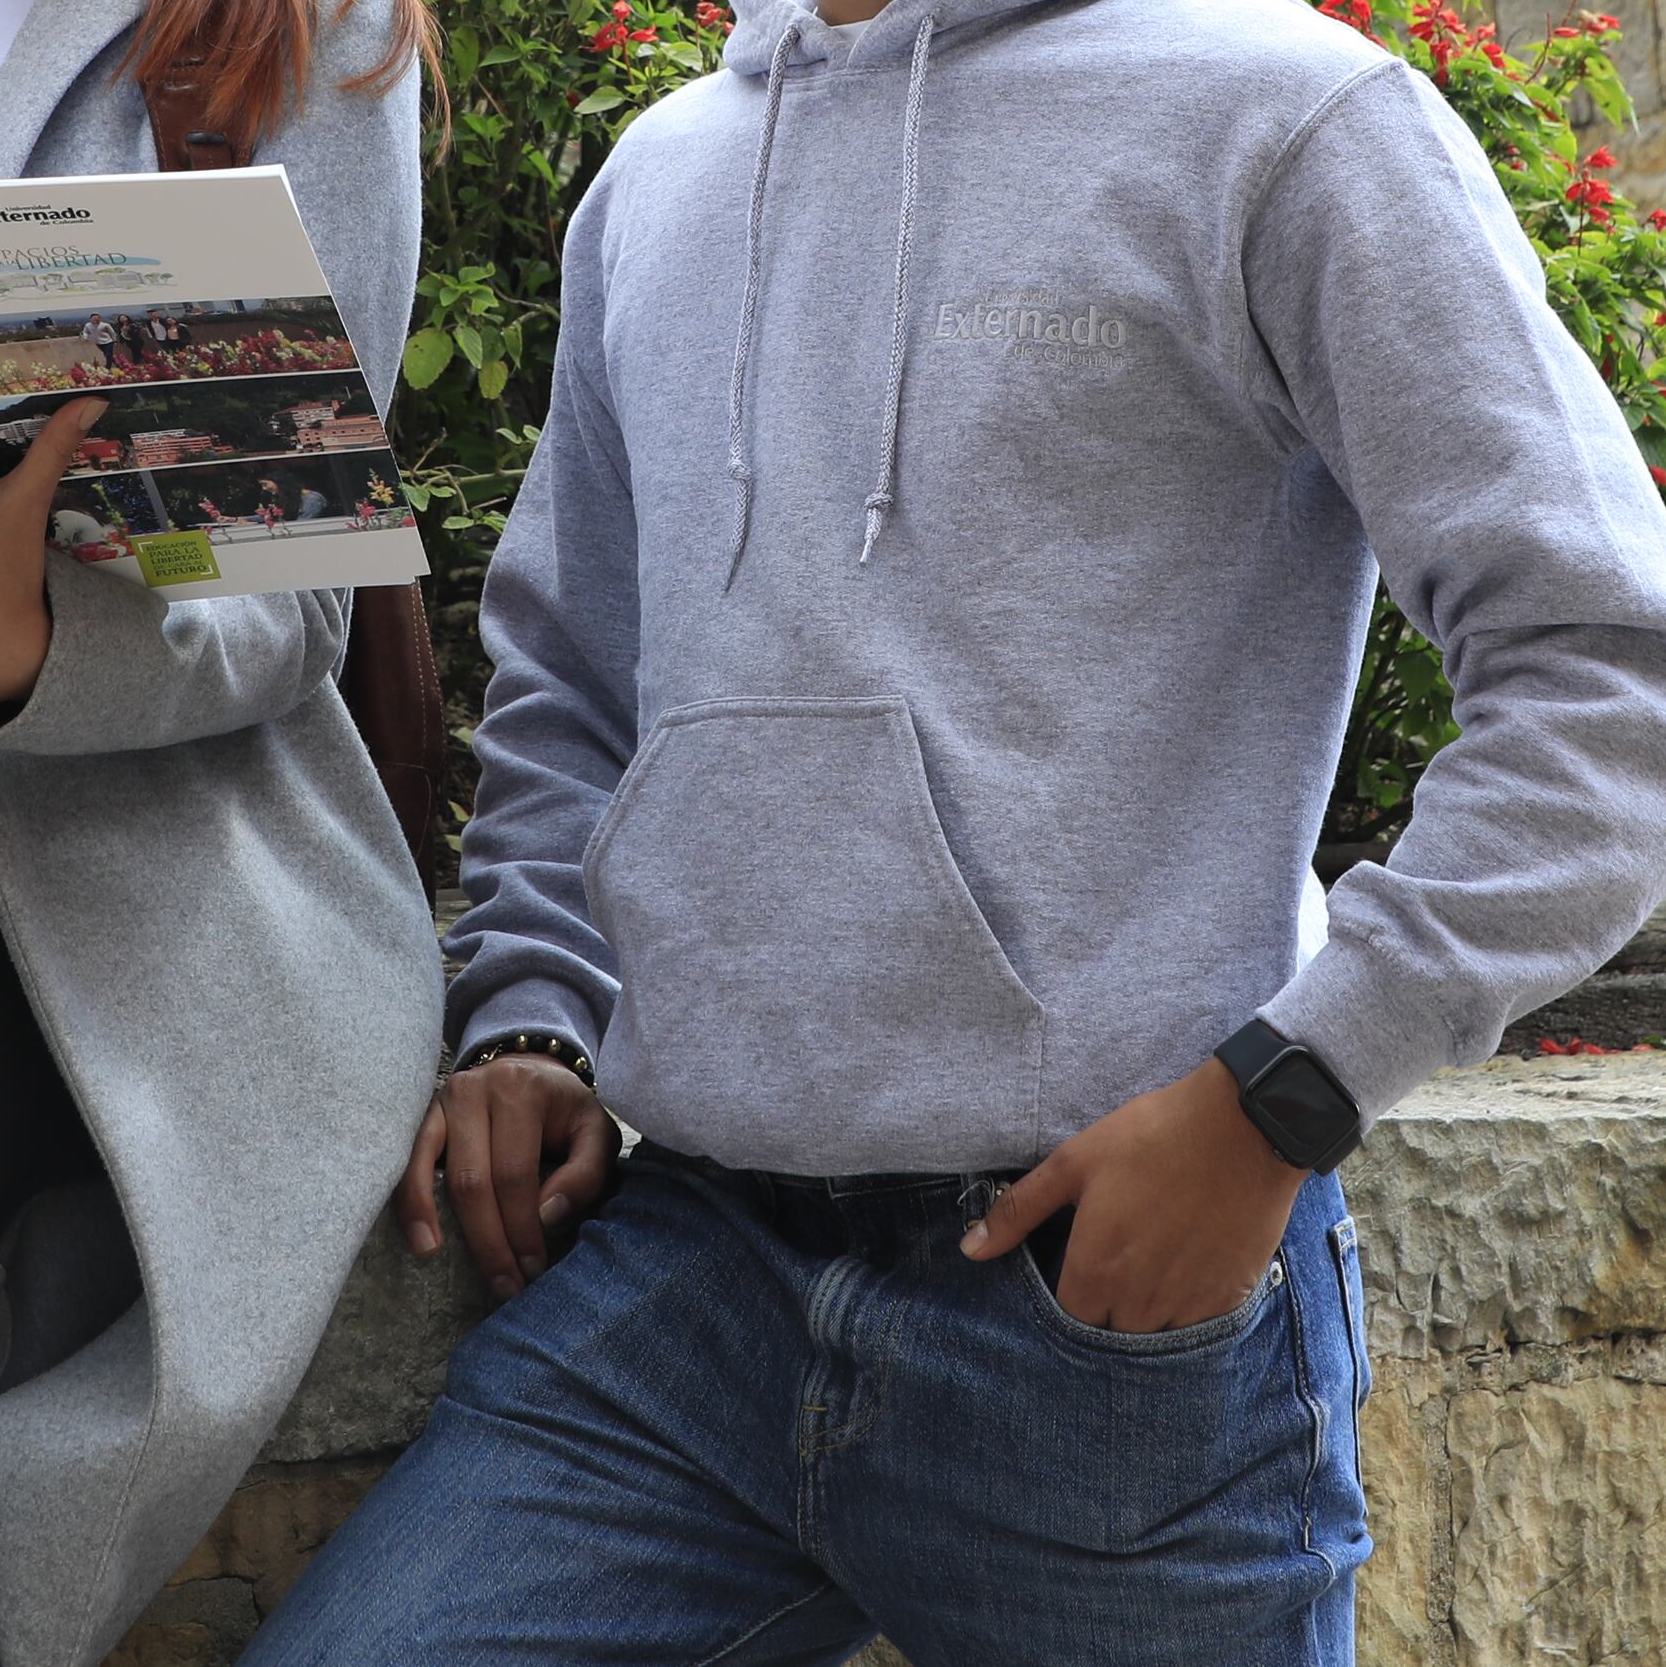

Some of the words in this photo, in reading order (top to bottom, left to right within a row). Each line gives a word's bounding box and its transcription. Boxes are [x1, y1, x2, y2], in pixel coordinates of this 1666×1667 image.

[15, 252, 127, 270] LIBERTAD
[933, 301, 1128, 350] Externado
[149, 548, 180, 558] PARA
[184, 546, 199, 554] LA
[151, 554, 203, 564] LIBERTAD
[155, 564, 207, 577] FUTURO
